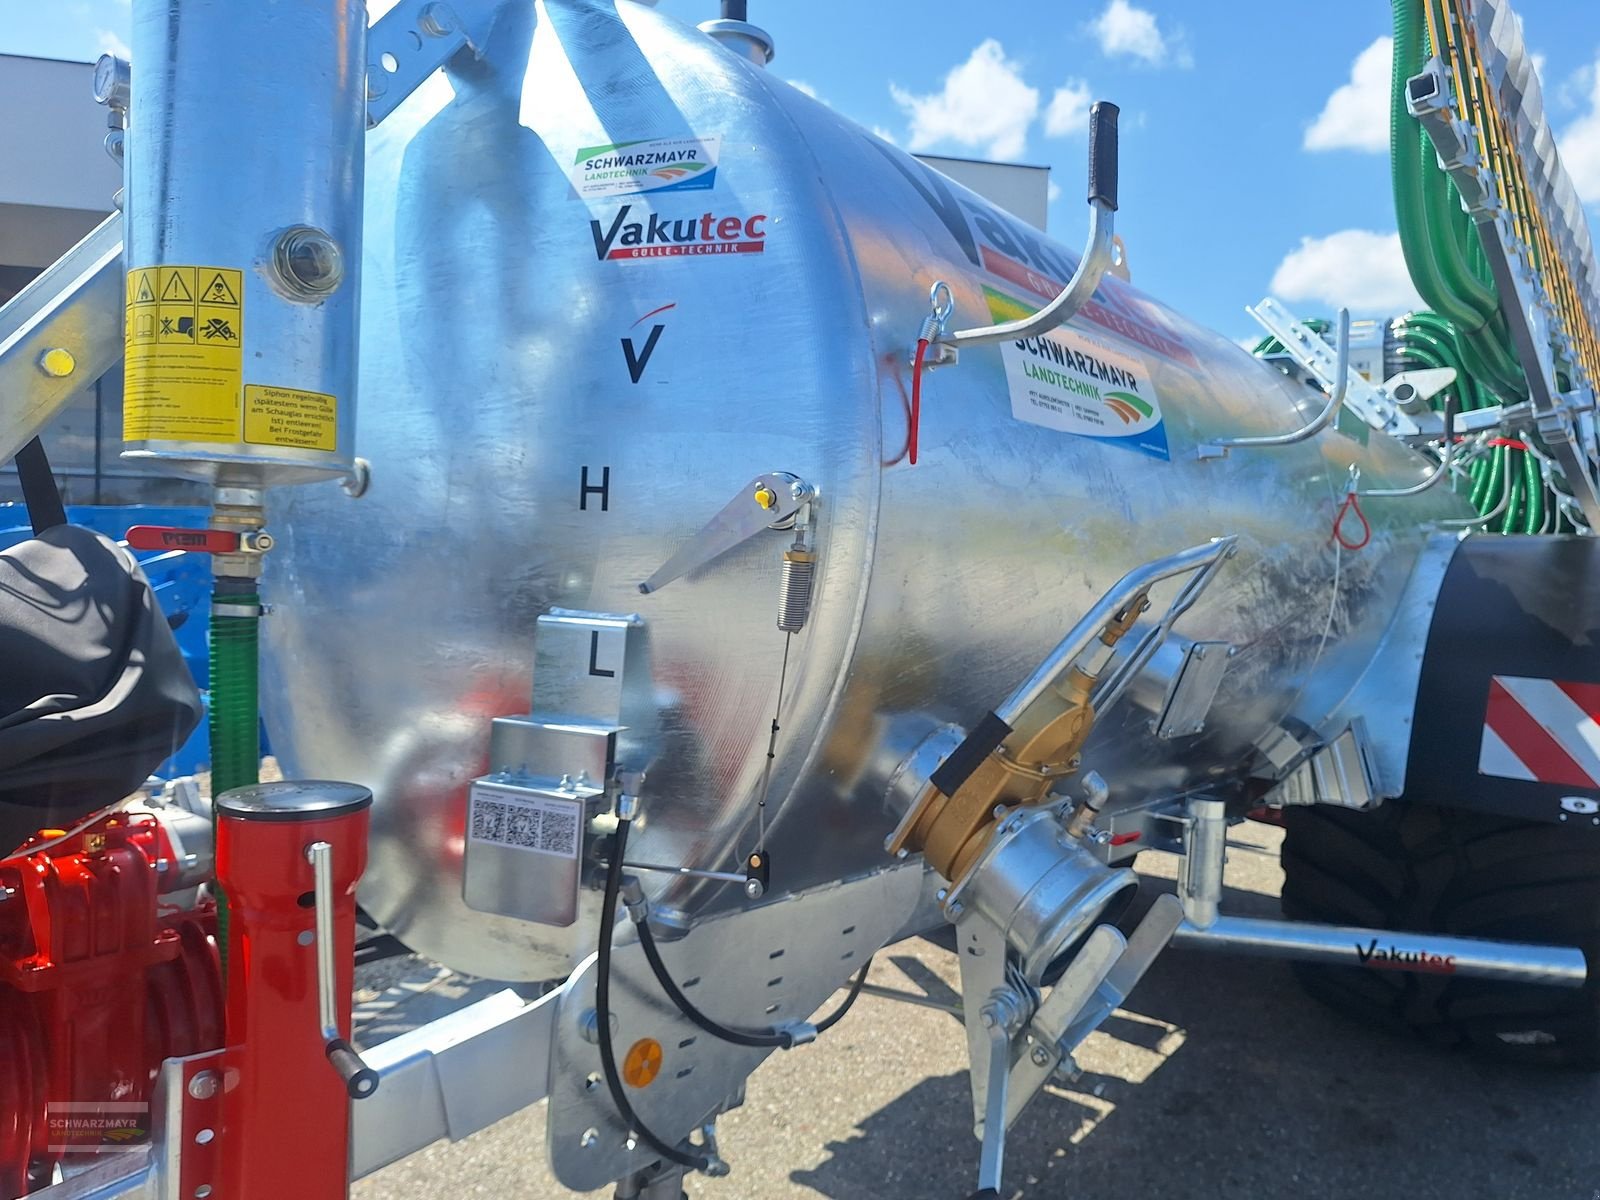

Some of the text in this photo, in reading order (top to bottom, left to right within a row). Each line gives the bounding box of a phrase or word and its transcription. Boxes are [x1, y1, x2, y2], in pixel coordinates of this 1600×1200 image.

[584, 149, 697, 170] SCHWARZMAYR
[584, 168, 648, 181] LANDTECHNIK
[590, 205, 767, 261] Vakutec
[620, 324, 665, 384] V
[264, 389, 290, 398] Siphon
[1022, 360, 1102, 401] LANDTECHNIK
[266, 407, 302, 418] Schauglas
[284, 427, 323, 438] Frostgefahr
[580, 466, 610, 511] H
[589, 630, 615, 678] L
[1355, 938, 1456, 966] Vakutec
